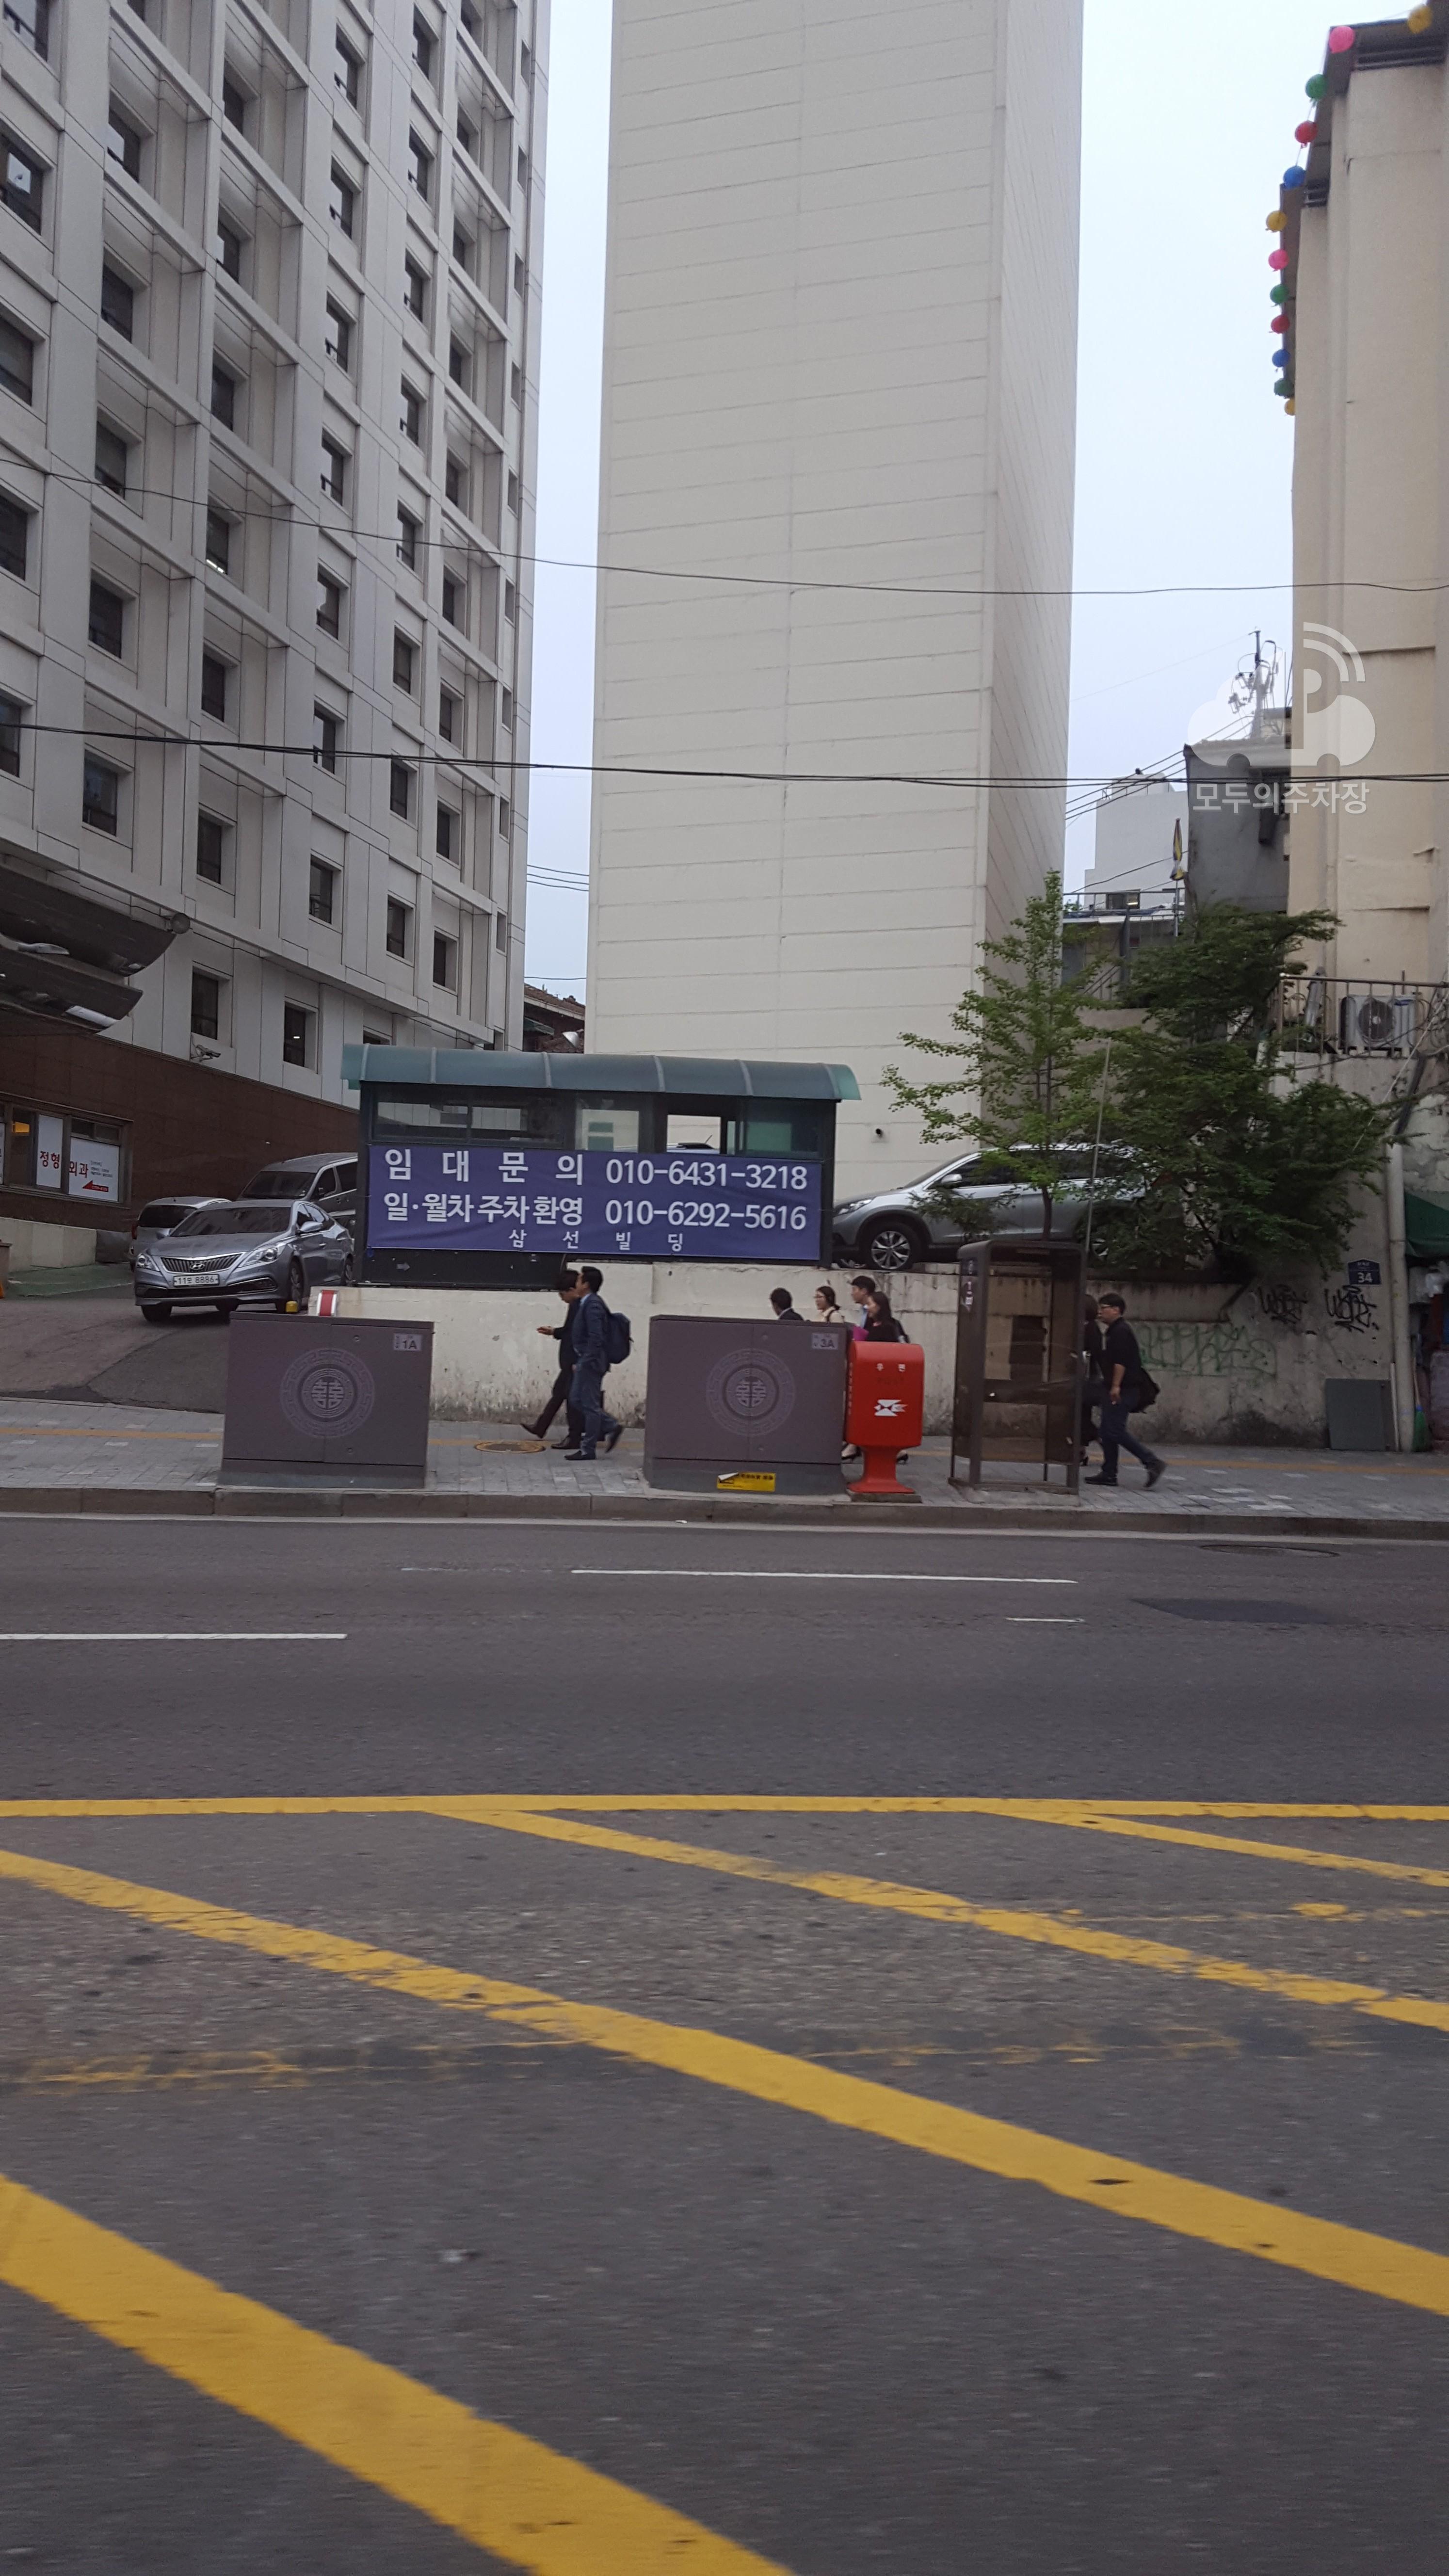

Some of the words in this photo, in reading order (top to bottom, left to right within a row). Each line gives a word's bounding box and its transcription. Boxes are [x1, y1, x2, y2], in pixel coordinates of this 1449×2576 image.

[606, 1159, 807, 1190] 010-6431-3218
[532, 1196, 582, 1226] 환영
[605, 1199, 806, 1231] 010-6292-5616
[1357, 1272, 1373, 1283] 34
[402, 1339, 418, 1350] 1A
[820, 1338, 835, 1348] 3A
